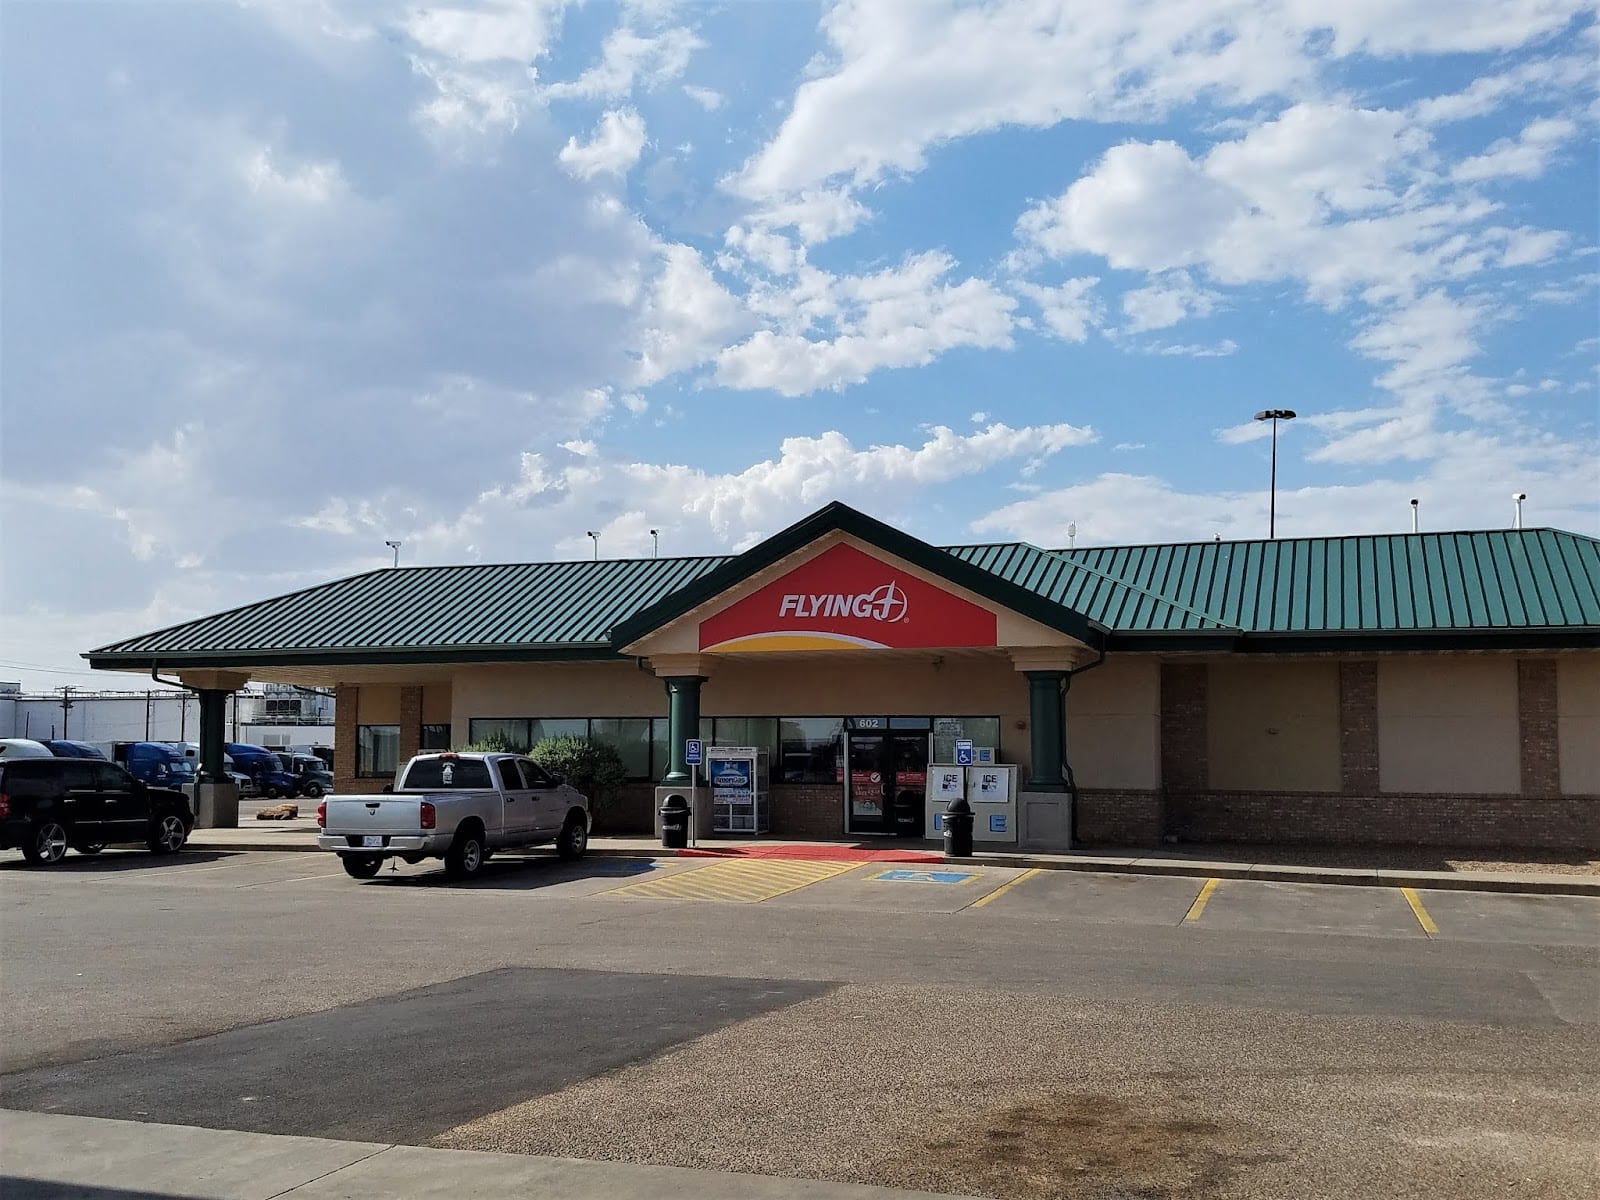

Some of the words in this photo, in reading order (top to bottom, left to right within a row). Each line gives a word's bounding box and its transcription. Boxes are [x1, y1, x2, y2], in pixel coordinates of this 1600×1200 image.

[779, 594, 872, 617] FLYING
[860, 719, 879, 728] 602
[943, 774, 958, 783] ICE
[983, 774, 997, 783] ICE
